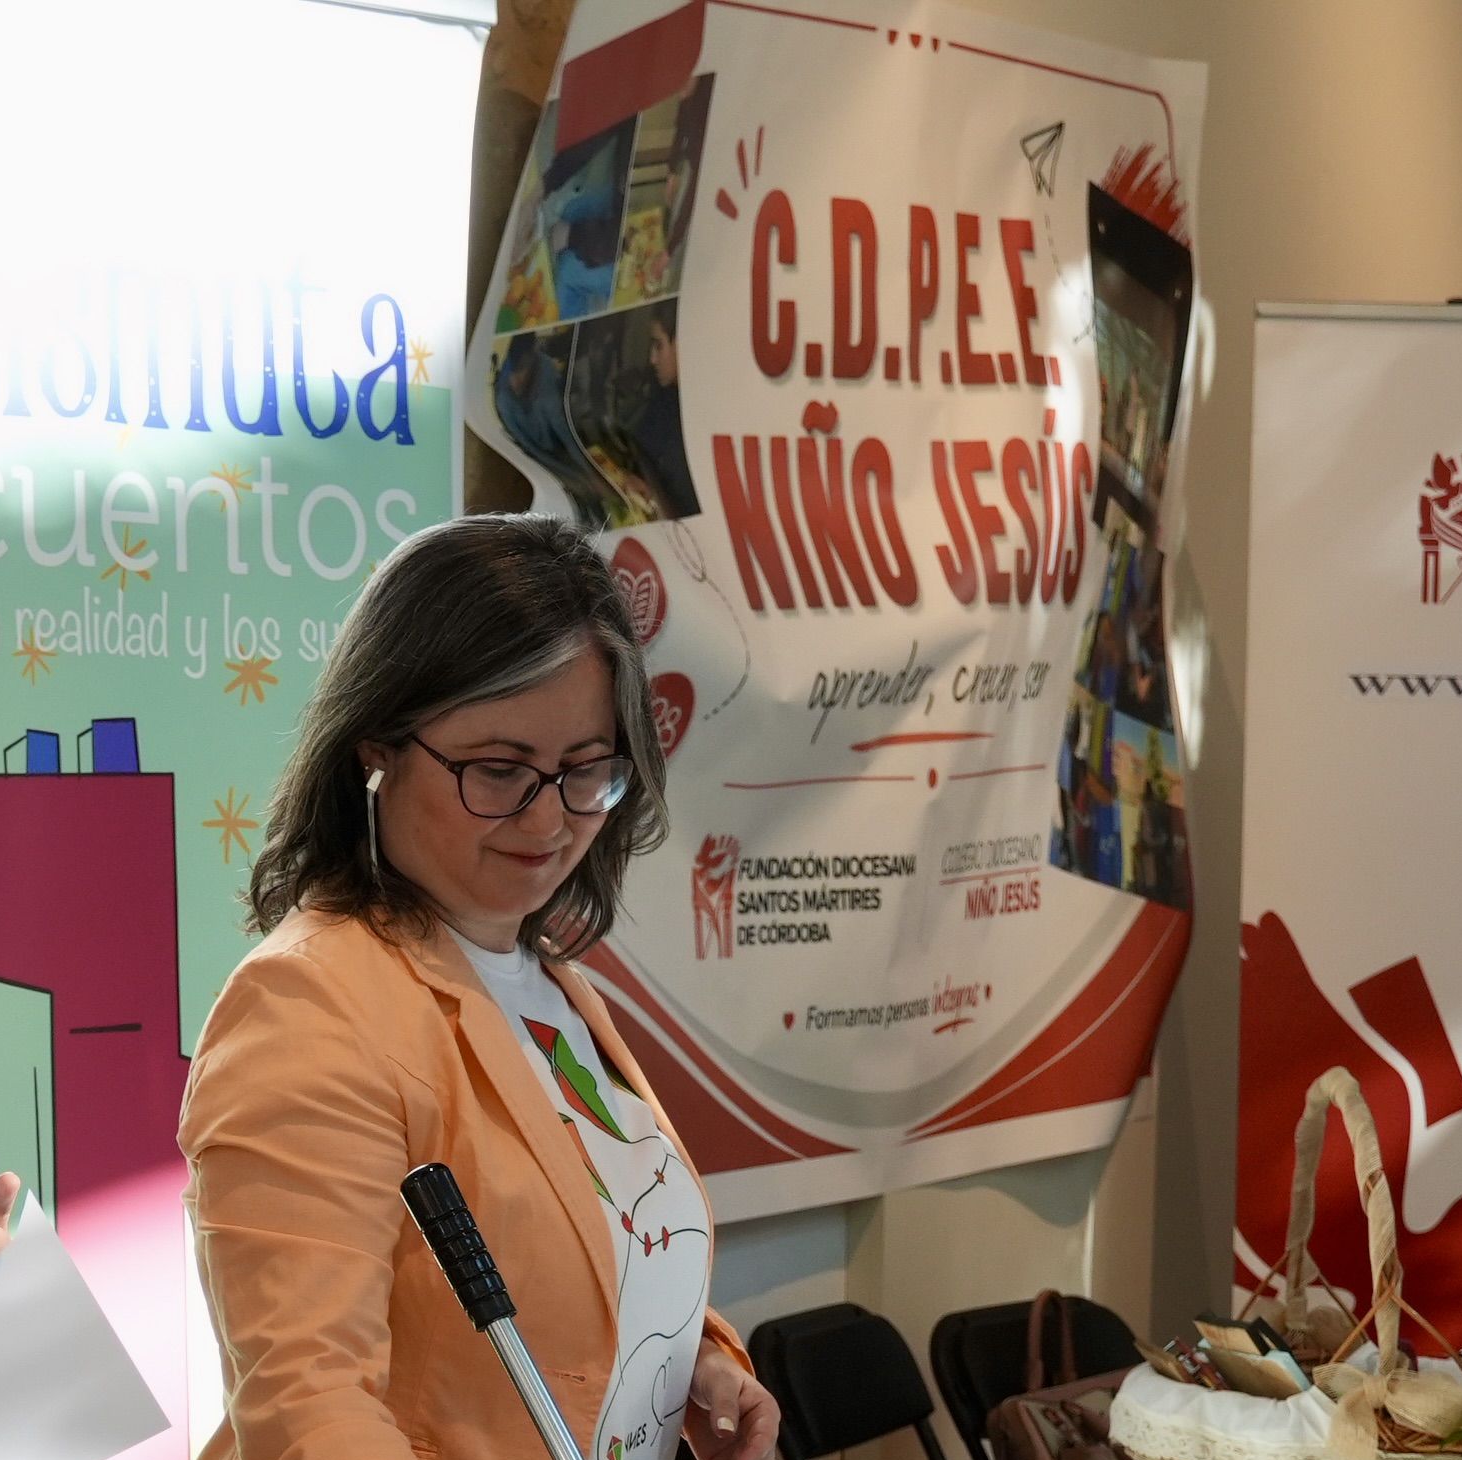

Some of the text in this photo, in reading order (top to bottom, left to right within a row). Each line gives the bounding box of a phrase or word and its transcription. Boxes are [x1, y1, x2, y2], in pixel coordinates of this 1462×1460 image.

[751, 189, 1063, 387] C.D.P.E.E.
[712, 401, 1094, 612] NIÑO JESÚS
[14, 586, 168, 660] realidad
[184, 616, 208, 679] y
[223, 595, 281, 663] los
[808, 640, 935, 745] aprender,
[739, 850, 830, 881] FUNDACIÓN
[738, 882, 882, 915] SANTOS MÁRTIRES
[737, 920, 832, 946] DE CÓRDOBA
[805, 1003, 884, 1030] Formamos
